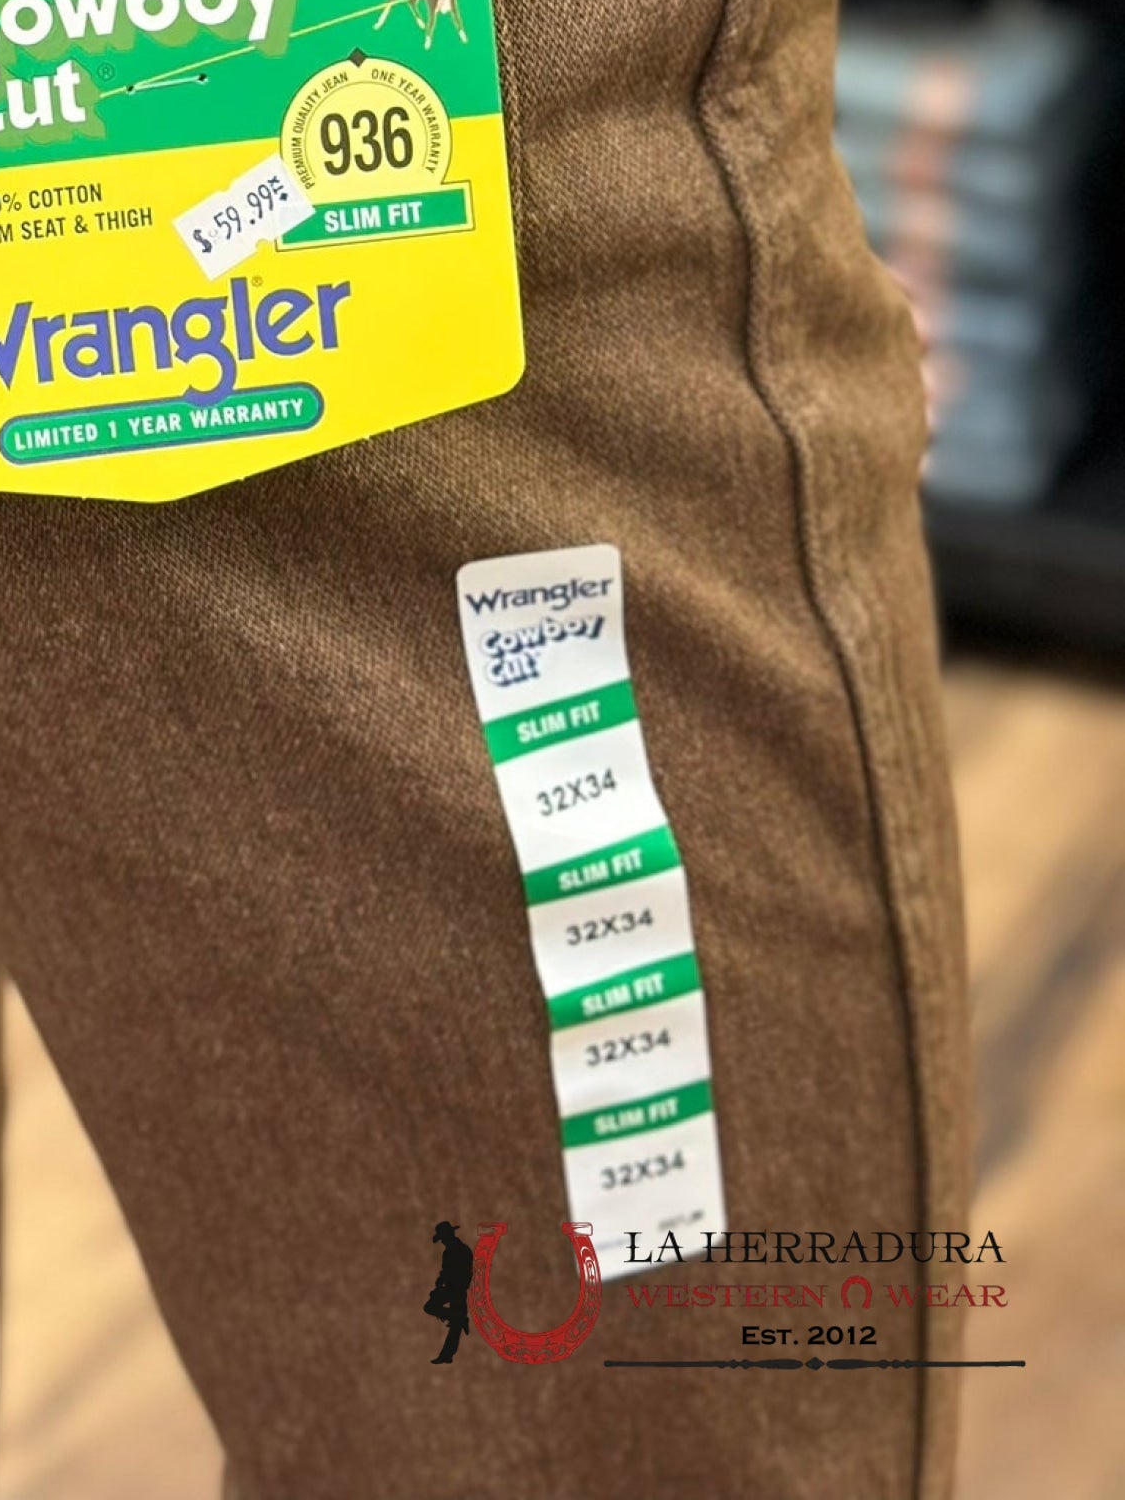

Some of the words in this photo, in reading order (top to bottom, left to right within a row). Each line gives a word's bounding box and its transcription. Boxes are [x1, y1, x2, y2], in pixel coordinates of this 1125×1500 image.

[322, 71, 349, 94] JEAN
[292, 89, 322, 134] QUALITY
[371, 68, 395, 85] ONE
[397, 77, 426, 105] YEAR
[422, 102, 442, 174] WARRANTY
[320, 106, 413, 176] 936
[290, 137, 316, 190] PREMIUM
[28, 183, 102, 210] COTTON
[324, 205, 381, 233] SLIM
[388, 201, 423, 227] FIT
[21, 217, 66, 240] SEAT
[74, 214, 89, 234] &
[94, 207, 153, 232] THIGH
[13, 422, 99, 451] LIMITED
[107, 420, 118, 439] 1
[128, 412, 183, 436] YEAR
[190, 398, 306, 429] WARRANTY
[465, 578, 613, 615] Wrangler
[481, 614, 605, 659] Cowboy
[486, 653, 540, 687] Cut
[517, 711, 567, 743] SLIM
[570, 701, 601, 729] FIT
[536, 768, 617, 817] 32X34
[558, 860, 609, 891] SLIM
[611, 847, 643, 877] FIT
[565, 908, 654, 946] 32X34
[581, 984, 632, 1017] SLIM
[632, 972, 664, 998] FIT
[585, 1028, 671, 1067] 32X34
[593, 1107, 646, 1136] SLIM
[648, 1097, 678, 1123] FIT
[600, 1150, 685, 1190] 32X34
